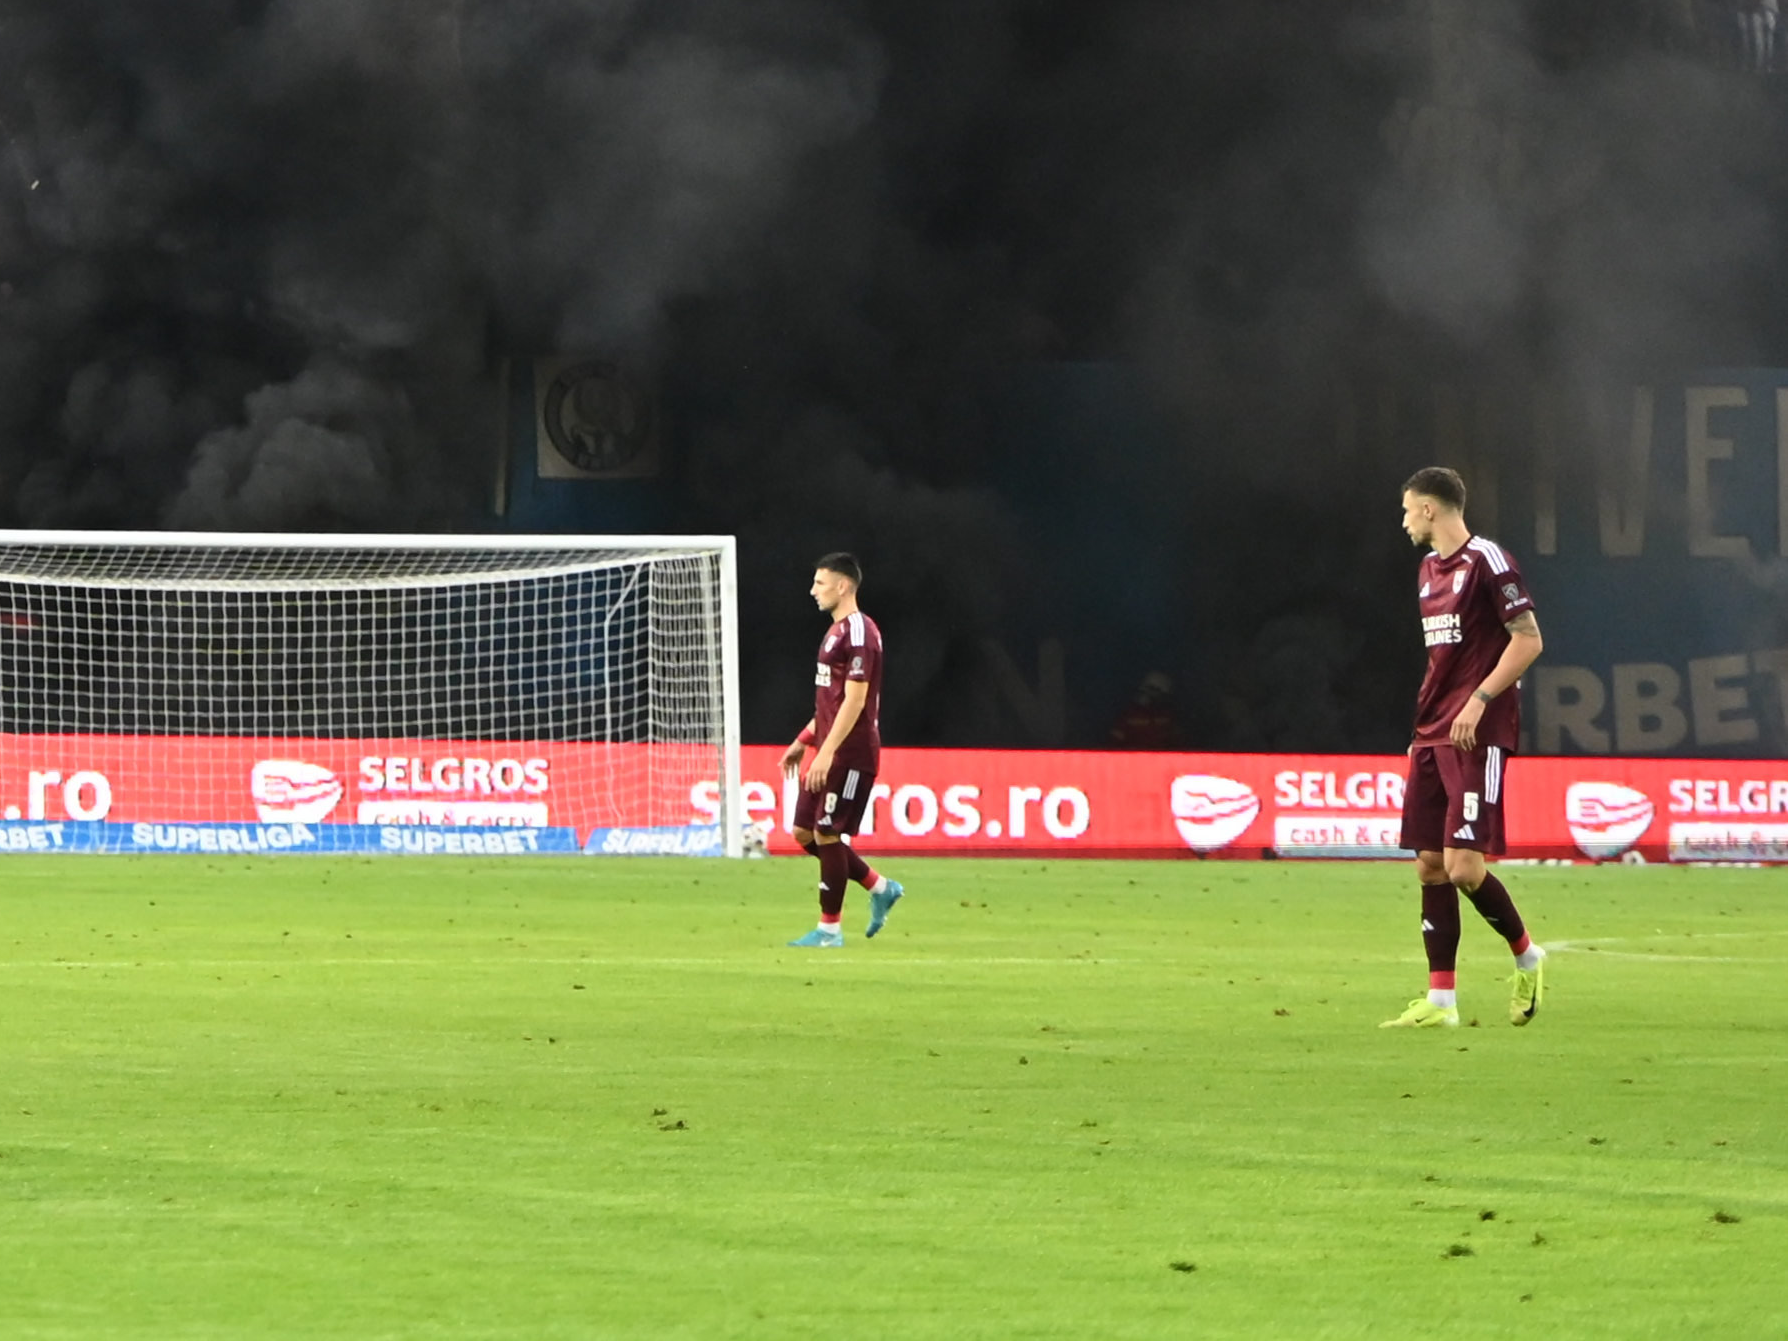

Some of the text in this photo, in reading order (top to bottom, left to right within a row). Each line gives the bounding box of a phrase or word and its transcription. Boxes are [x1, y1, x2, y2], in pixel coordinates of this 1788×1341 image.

[358, 757, 550, 795] SELGROS
[1274, 770, 1405, 808] SELGR
[825, 792, 838, 815] 8
[1463, 791, 1479, 822] 5
[132, 821, 316, 852] SUPERLIGA
[380, 826, 538, 855] SUPERBET
